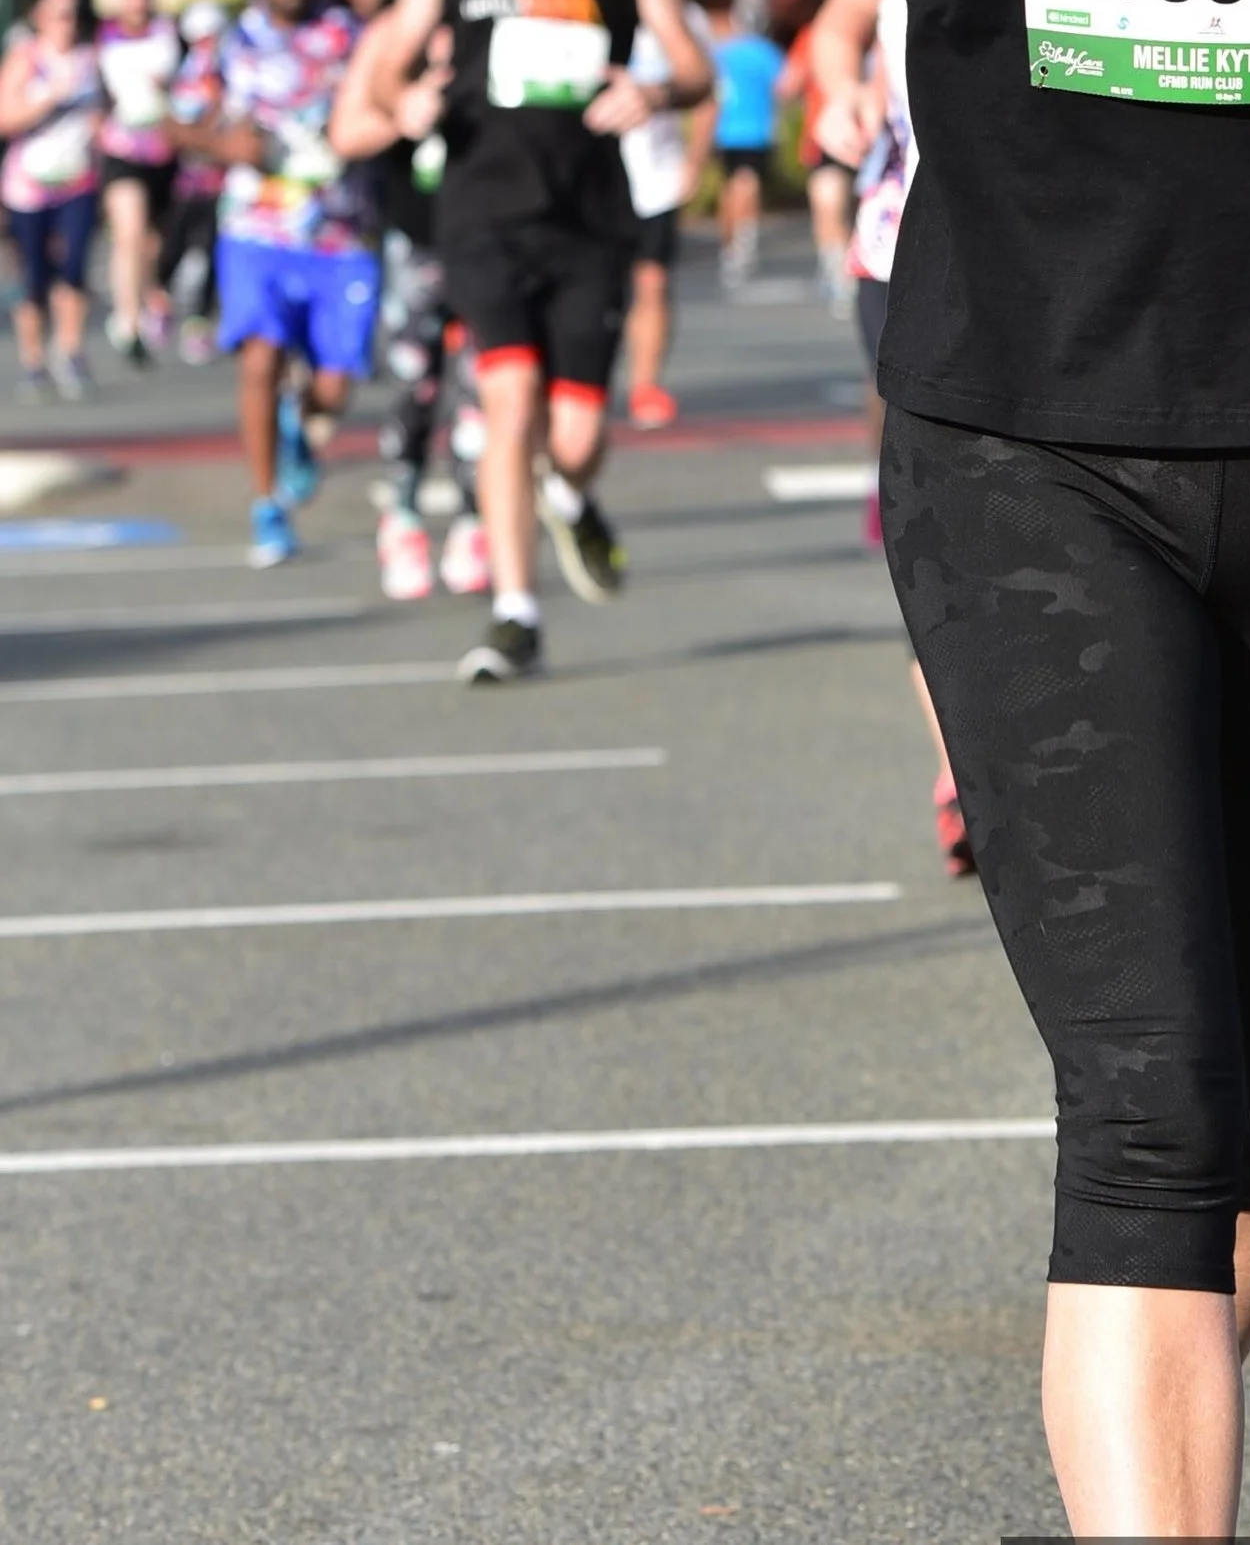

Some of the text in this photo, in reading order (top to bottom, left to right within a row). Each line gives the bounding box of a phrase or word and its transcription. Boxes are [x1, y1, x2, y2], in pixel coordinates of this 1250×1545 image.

[1133, 44, 1210, 73] MELLIE
[1158, 74, 1244, 91] CFMB RUN CLUB
